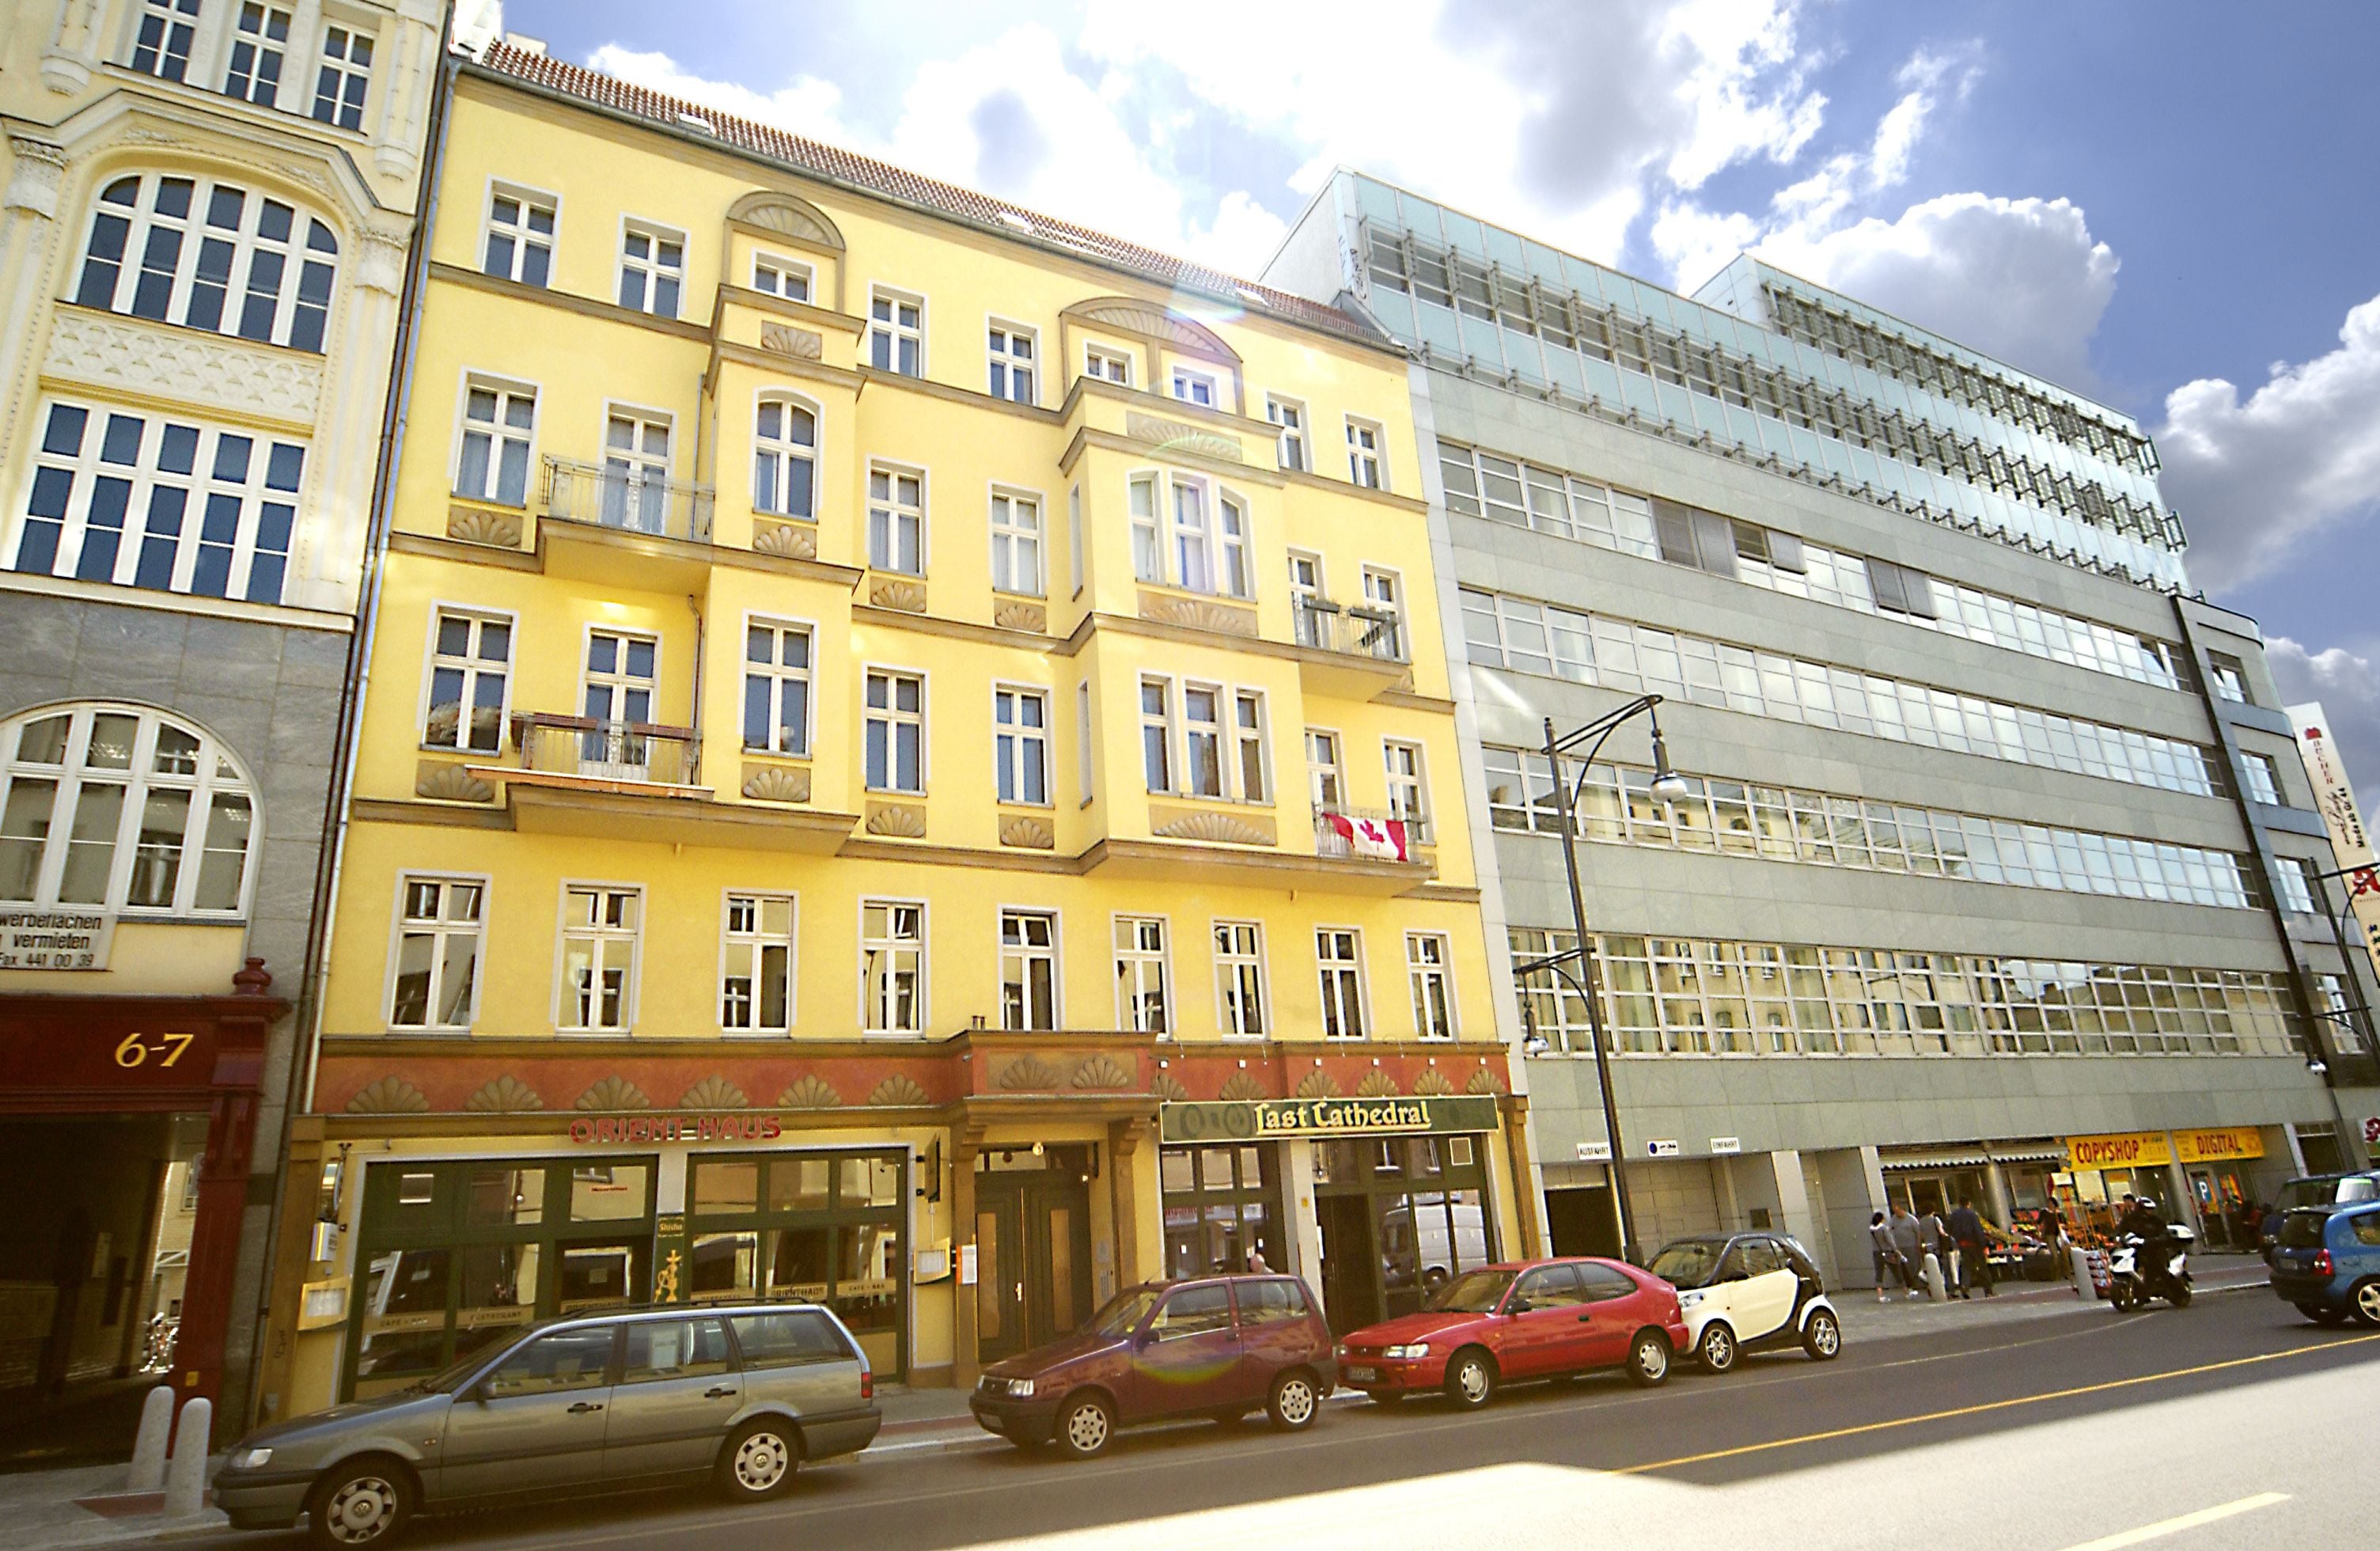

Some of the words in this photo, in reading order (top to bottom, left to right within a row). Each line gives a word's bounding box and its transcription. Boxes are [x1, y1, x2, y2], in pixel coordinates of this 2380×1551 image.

[13, 932, 90, 950] vermieten
[26, 953, 47, 965] 441
[115, 1033, 194, 1067] 6-7
[569, 1117, 688, 1143] ORIENT
[698, 1115, 781, 1140] HAUS
[1255, 1102, 1307, 1135] Last
[1312, 1101, 1431, 1128] Cathedral
[2075, 1139, 2139, 1163] COPYSHOP
[2196, 1133, 2240, 1155] DIGITAL
